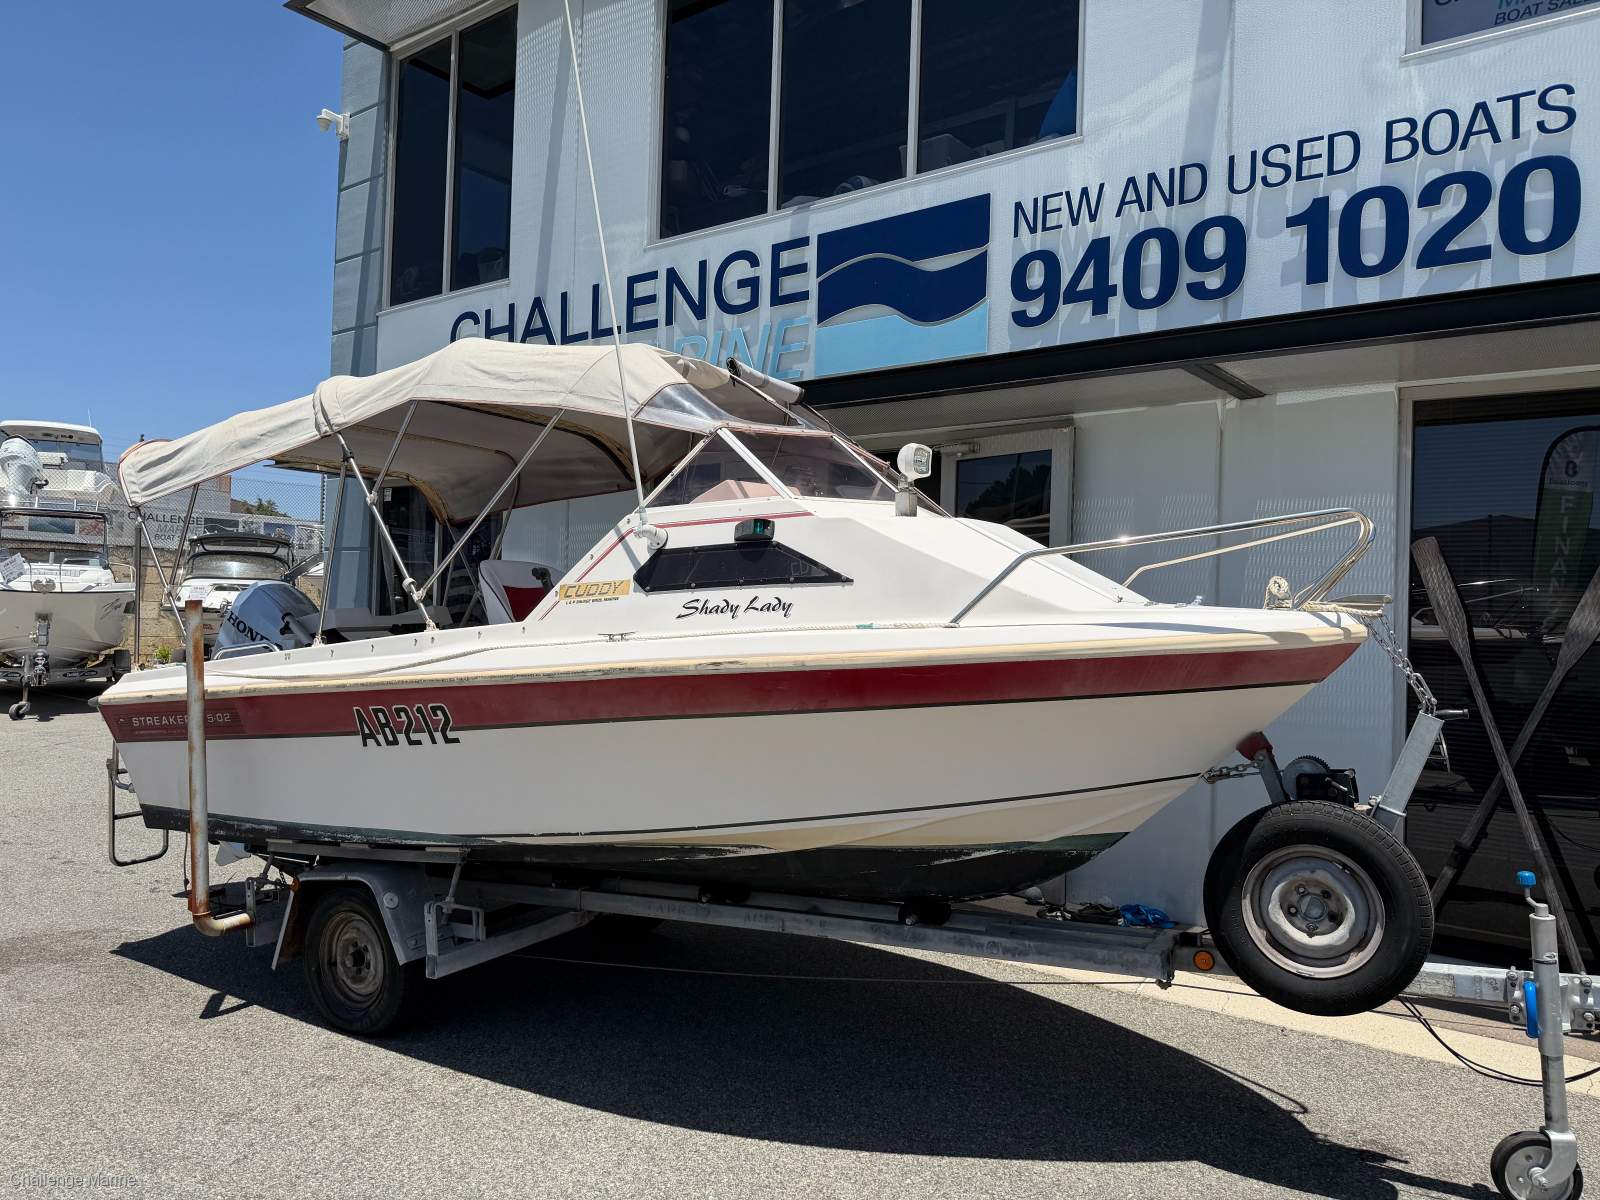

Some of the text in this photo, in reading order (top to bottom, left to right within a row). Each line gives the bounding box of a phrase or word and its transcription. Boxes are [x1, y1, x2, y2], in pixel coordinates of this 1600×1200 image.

[1494, 1, 1543, 25] BOAT
[1013, 83, 1577, 238] NEW AND USED BOATS
[1010, 155, 1582, 328] 9409 1020
[450, 236, 811, 346] CHALLENGE
[564, 580, 623, 598] CUDDY
[675, 596, 794, 619] Shady Lady
[353, 703, 461, 747] AB212
